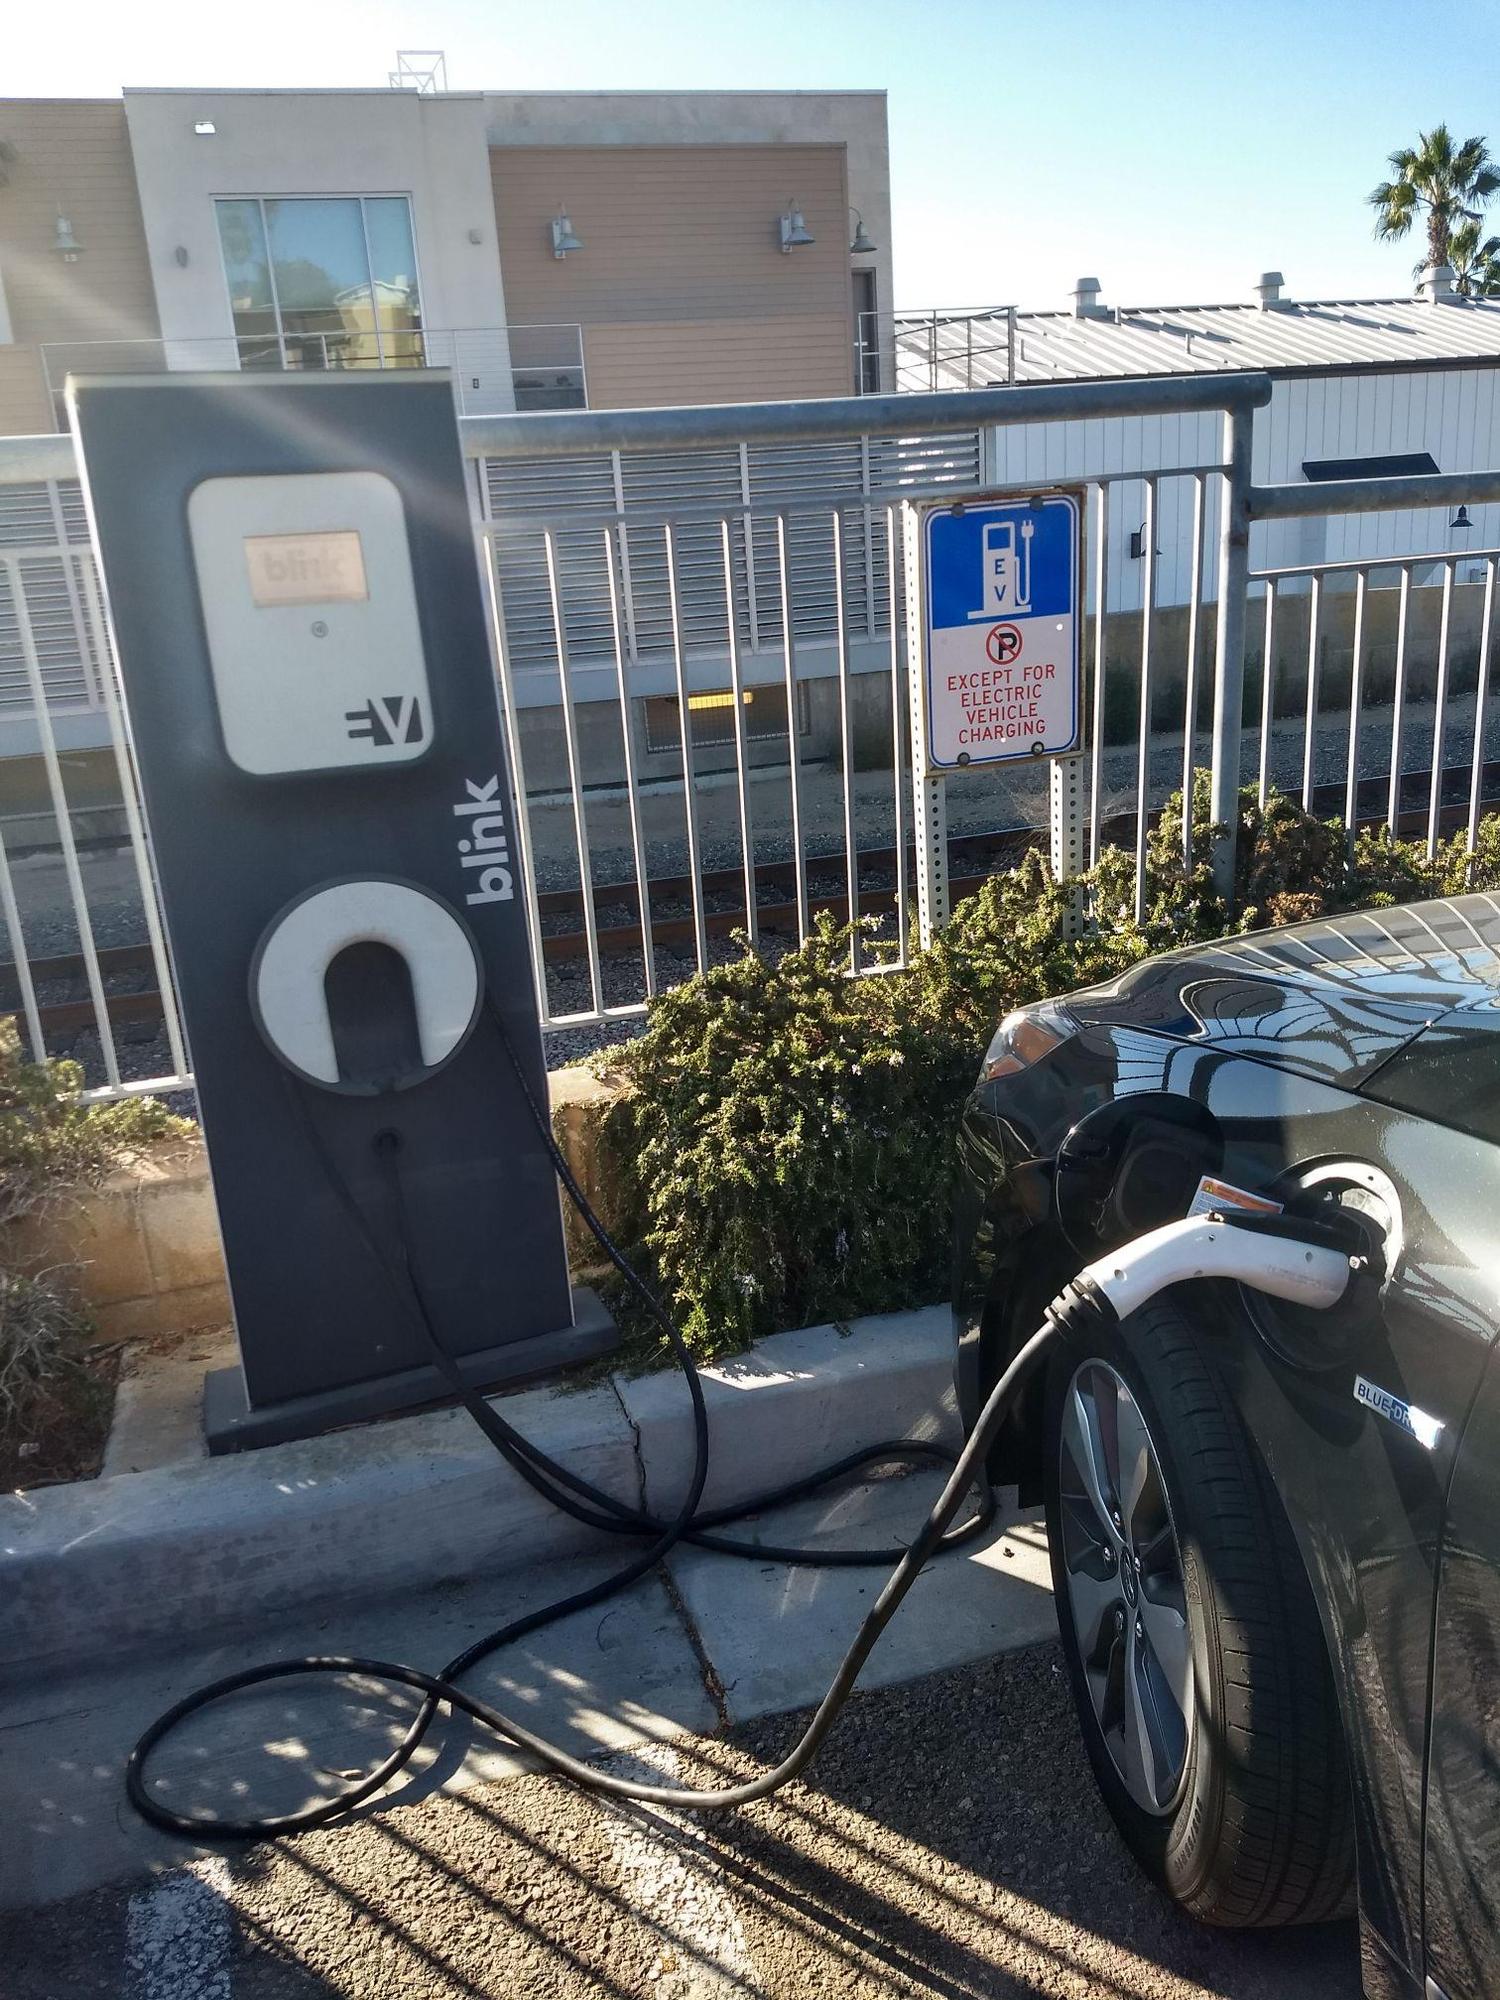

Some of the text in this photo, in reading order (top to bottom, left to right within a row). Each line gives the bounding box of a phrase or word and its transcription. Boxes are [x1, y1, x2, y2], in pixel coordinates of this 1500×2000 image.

[263, 547, 345, 583] blink
[999, 632, 1018, 660] P
[948, 664, 1056, 691] EXCEPT FOR
[961, 684, 1042, 708] ELECTRIC
[966, 702, 1038, 725] VEHICLE
[959, 719, 1046, 744] CHARGING
[453, 774, 514, 905] blink
[1357, 1383, 1416, 1431] BLUE-DR
